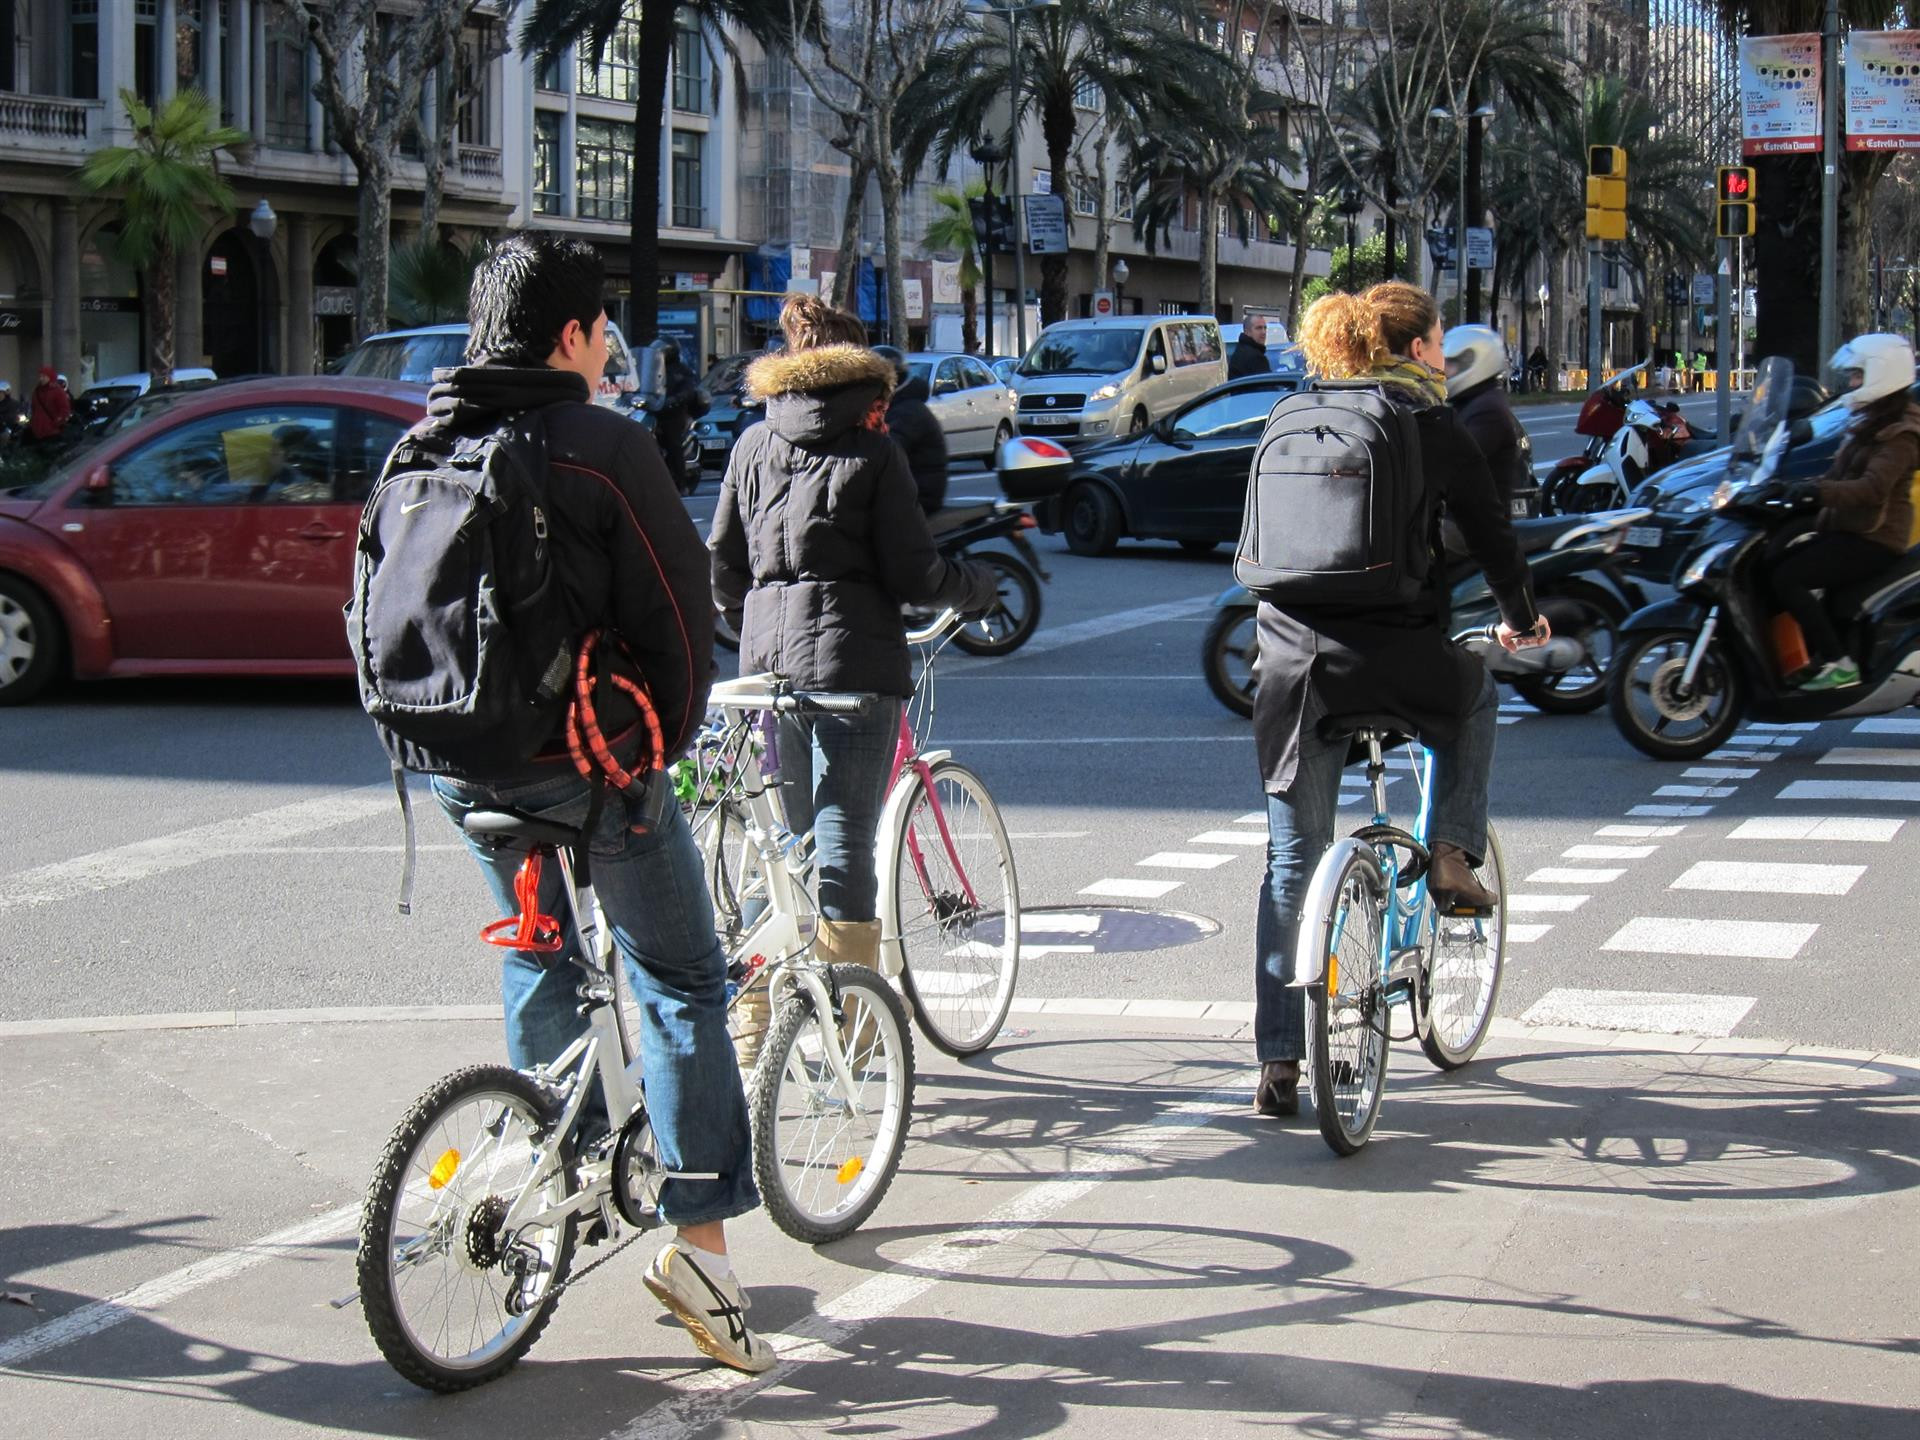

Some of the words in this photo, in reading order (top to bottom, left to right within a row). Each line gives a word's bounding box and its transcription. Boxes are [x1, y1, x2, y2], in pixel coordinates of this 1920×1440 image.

[1863, 62, 1880, 72] LOS
[1756, 67, 1772, 76] LOS
[1772, 67, 1817, 80] PILOTOS
[1763, 142, 1792, 151] Estrella
[1793, 141, 1816, 150] Damm
[1866, 138, 1898, 148] Estrella
